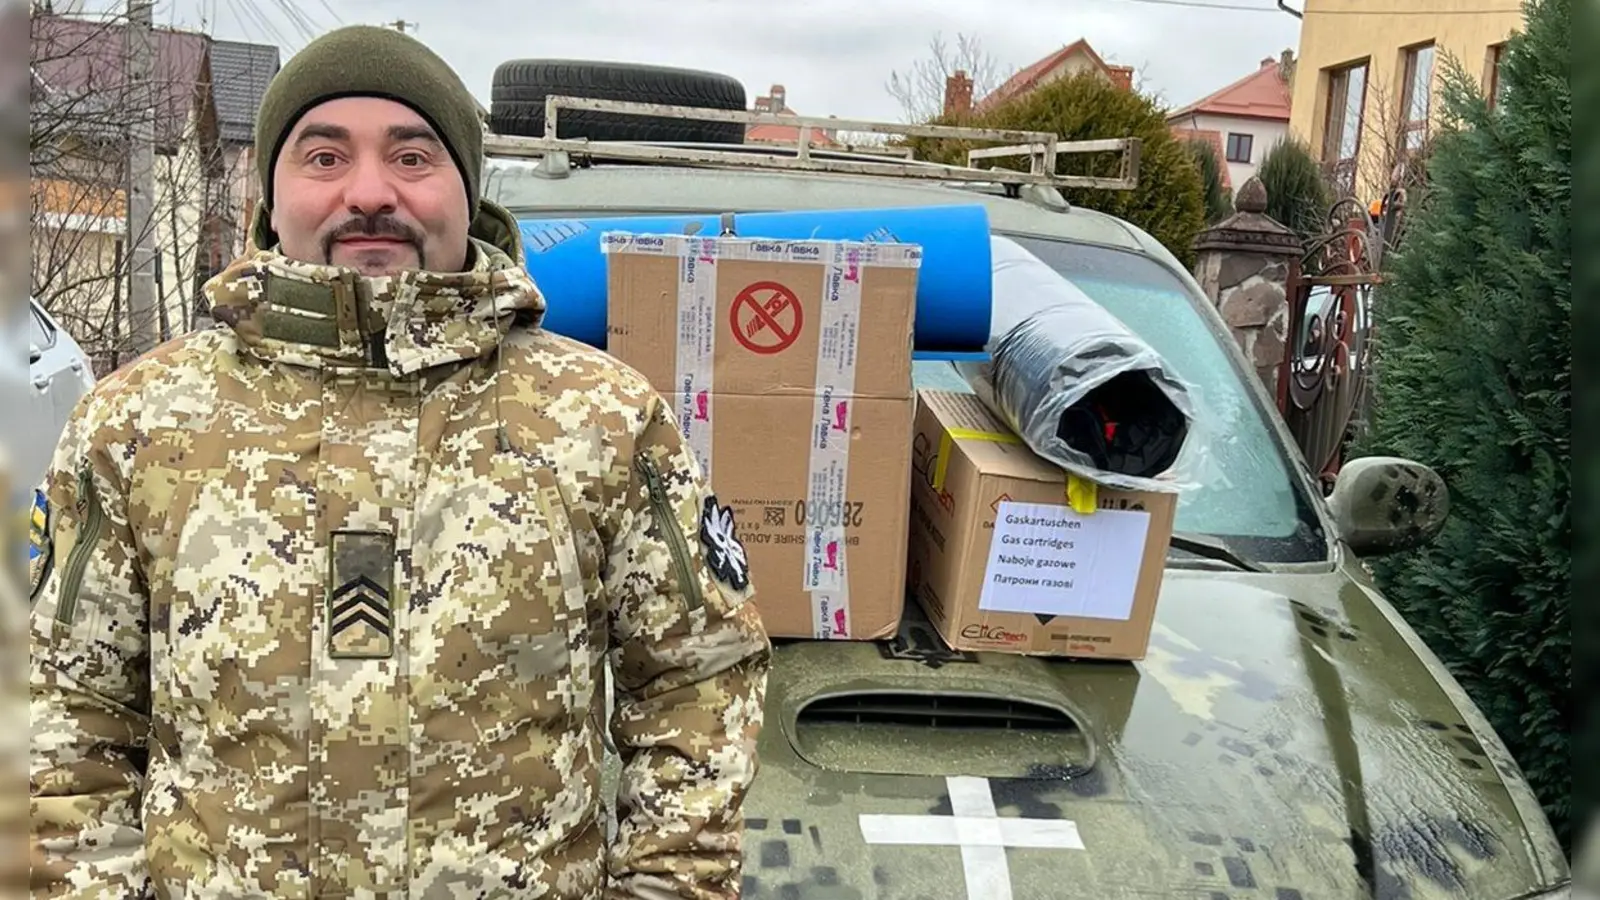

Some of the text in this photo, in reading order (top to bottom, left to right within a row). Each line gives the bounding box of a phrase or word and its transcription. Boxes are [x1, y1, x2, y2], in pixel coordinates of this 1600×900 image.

[750, 241, 820, 255] Гавка Лавка
[687, 256, 695, 283] авка
[831, 266, 843, 301] Лавка
[683, 373, 694, 439] Гавка Лавка
[819, 385, 834, 449] Гавка Лавка
[795, 499, 864, 528] 286060
[1005, 514, 1081, 529] Gaskartuschen
[1002, 534, 1075, 549] Gas cartridges
[811, 525, 824, 587] Гавка Лавка
[998, 554, 1076, 569] Naboje gazowe
[993, 574, 1074, 589] Патрони газові
[819, 595, 830, 623] Гавка
